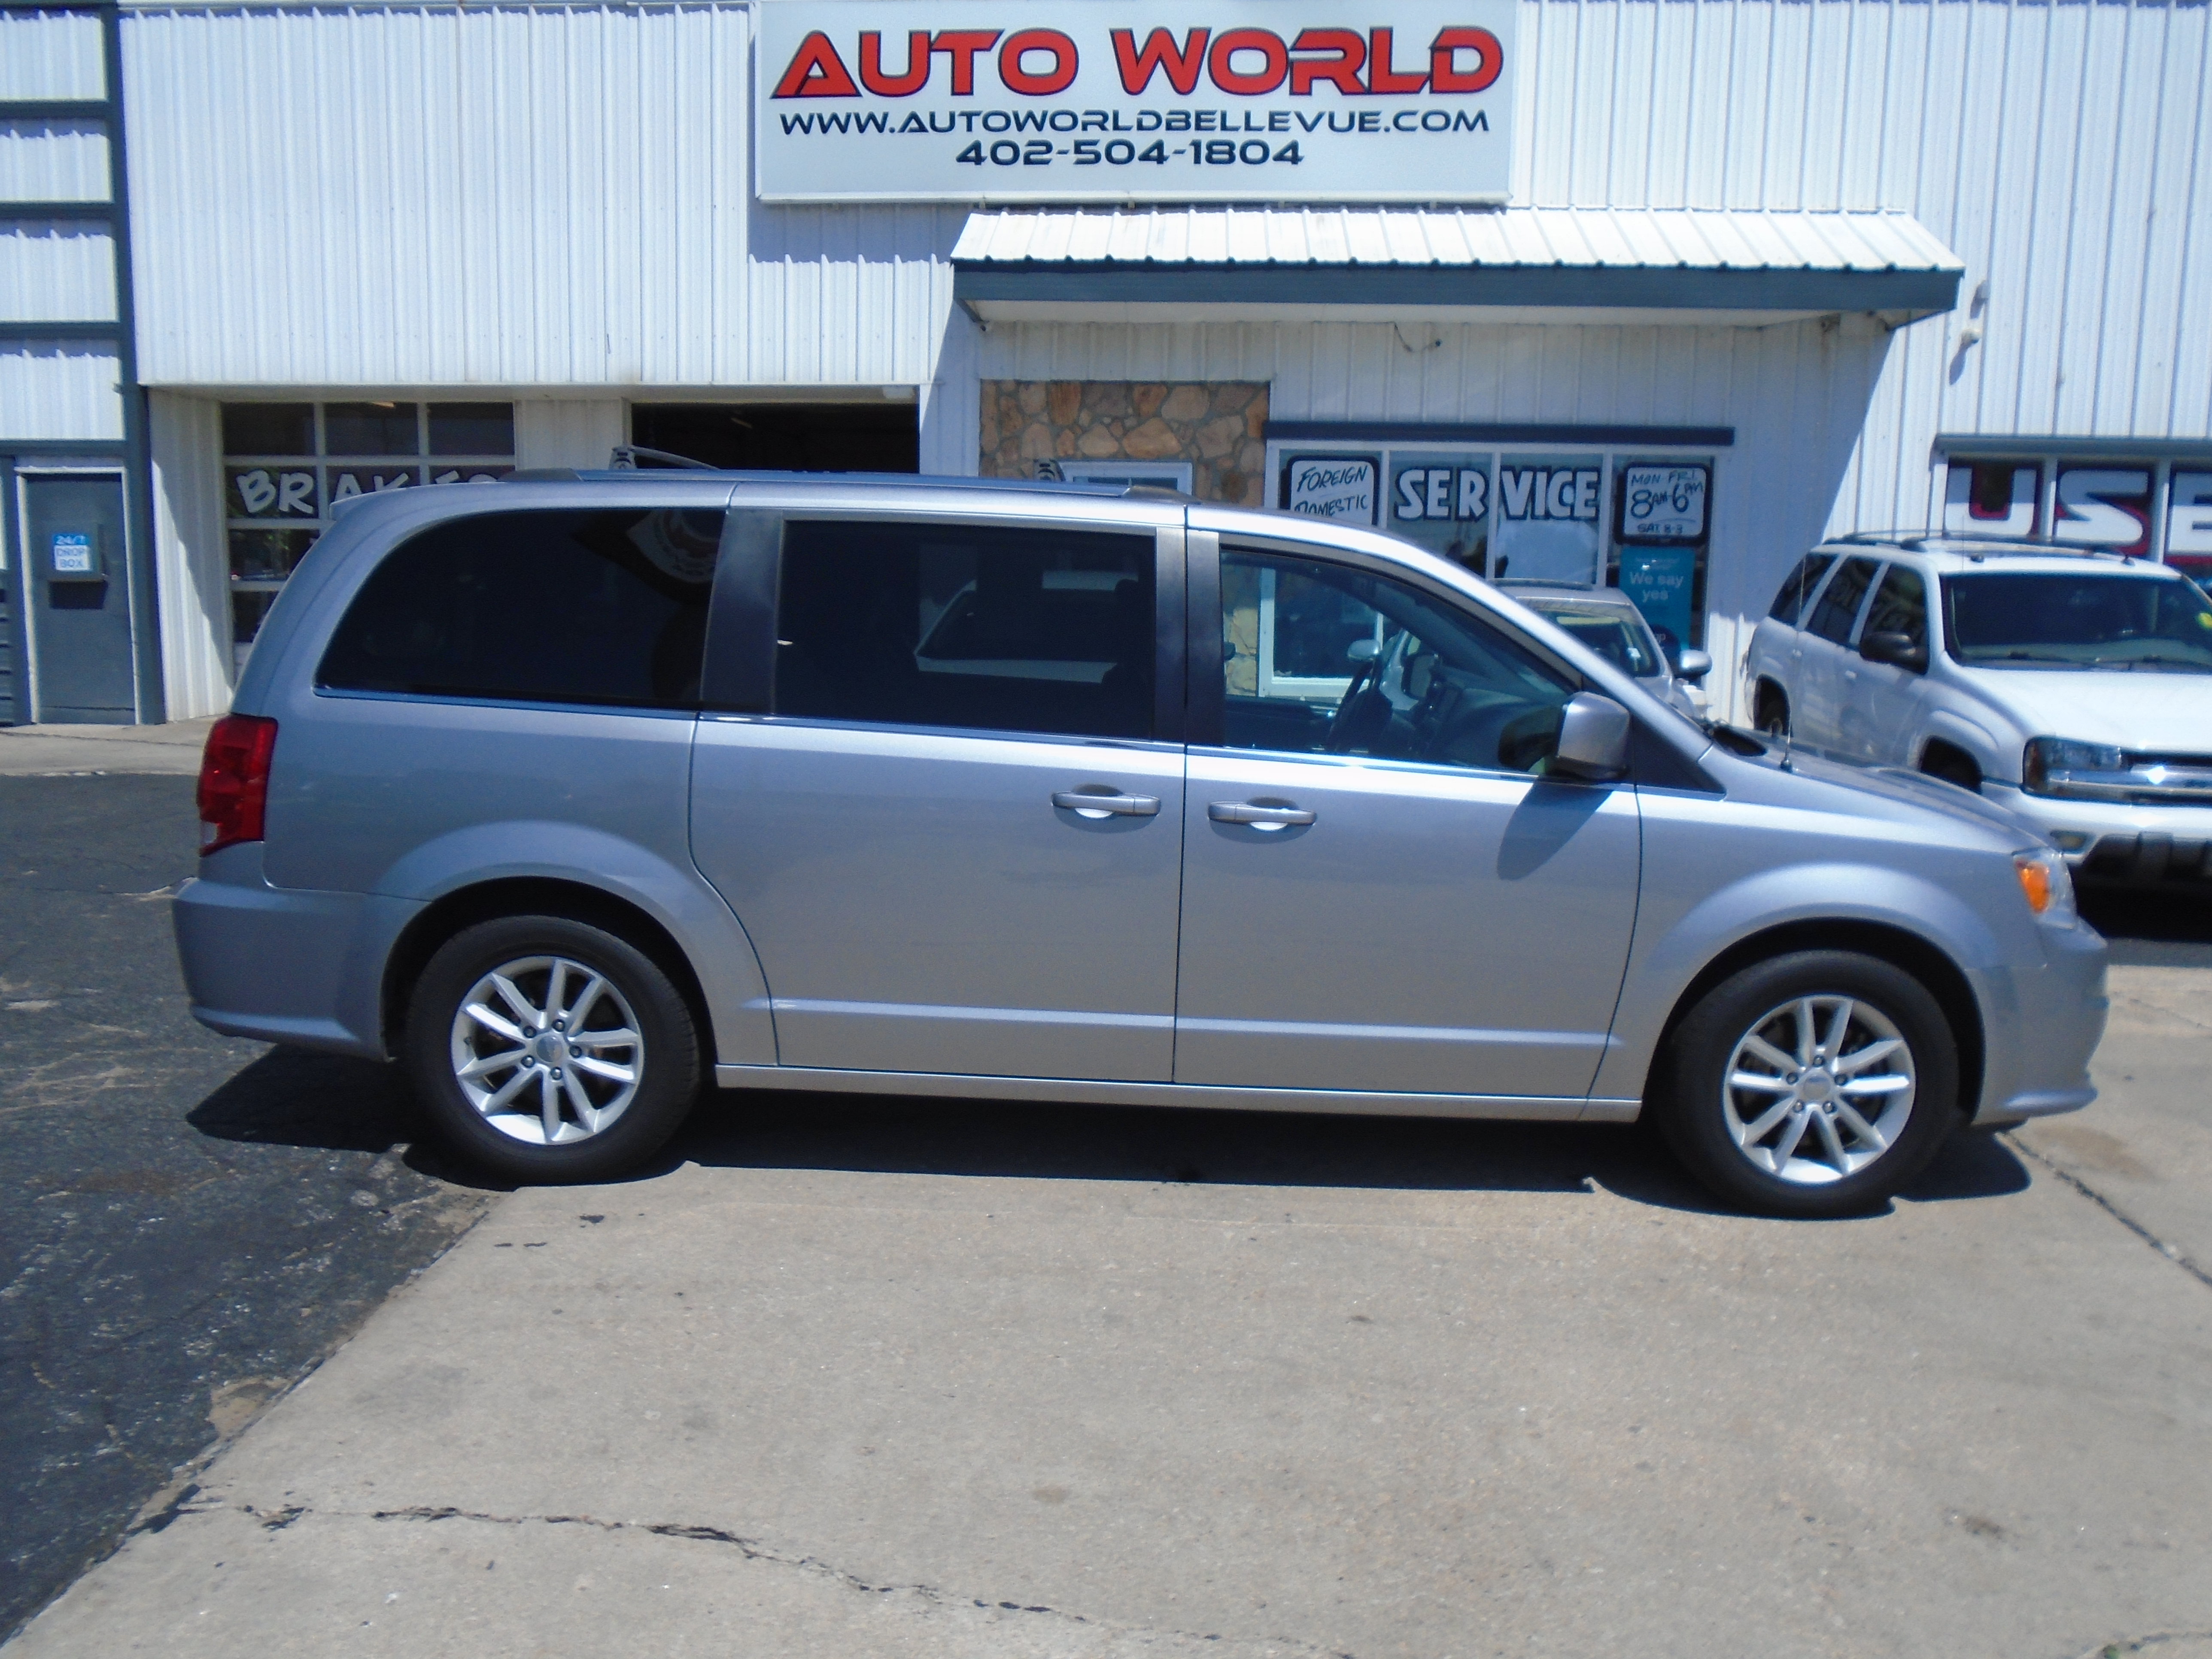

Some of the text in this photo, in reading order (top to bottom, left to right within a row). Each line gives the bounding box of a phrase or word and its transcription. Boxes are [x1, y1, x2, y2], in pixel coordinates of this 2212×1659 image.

[770, 26, 1503, 99] AUTO WORLD
[779, 109, 1489, 135] WWW.AUTOWORLDBELLEVUE.COM
[955, 139, 1304, 166] 402-504-1804
[1296, 465, 1368, 492] FOREIGN
[1631, 474, 1662, 486] MON
[1395, 466, 1601, 520] SERVICE
[57, 548, 85, 557] DROP
[60, 559, 83, 568] BOX
[1630, 571, 1684, 589] We say
[1642, 589, 1669, 602] yes
